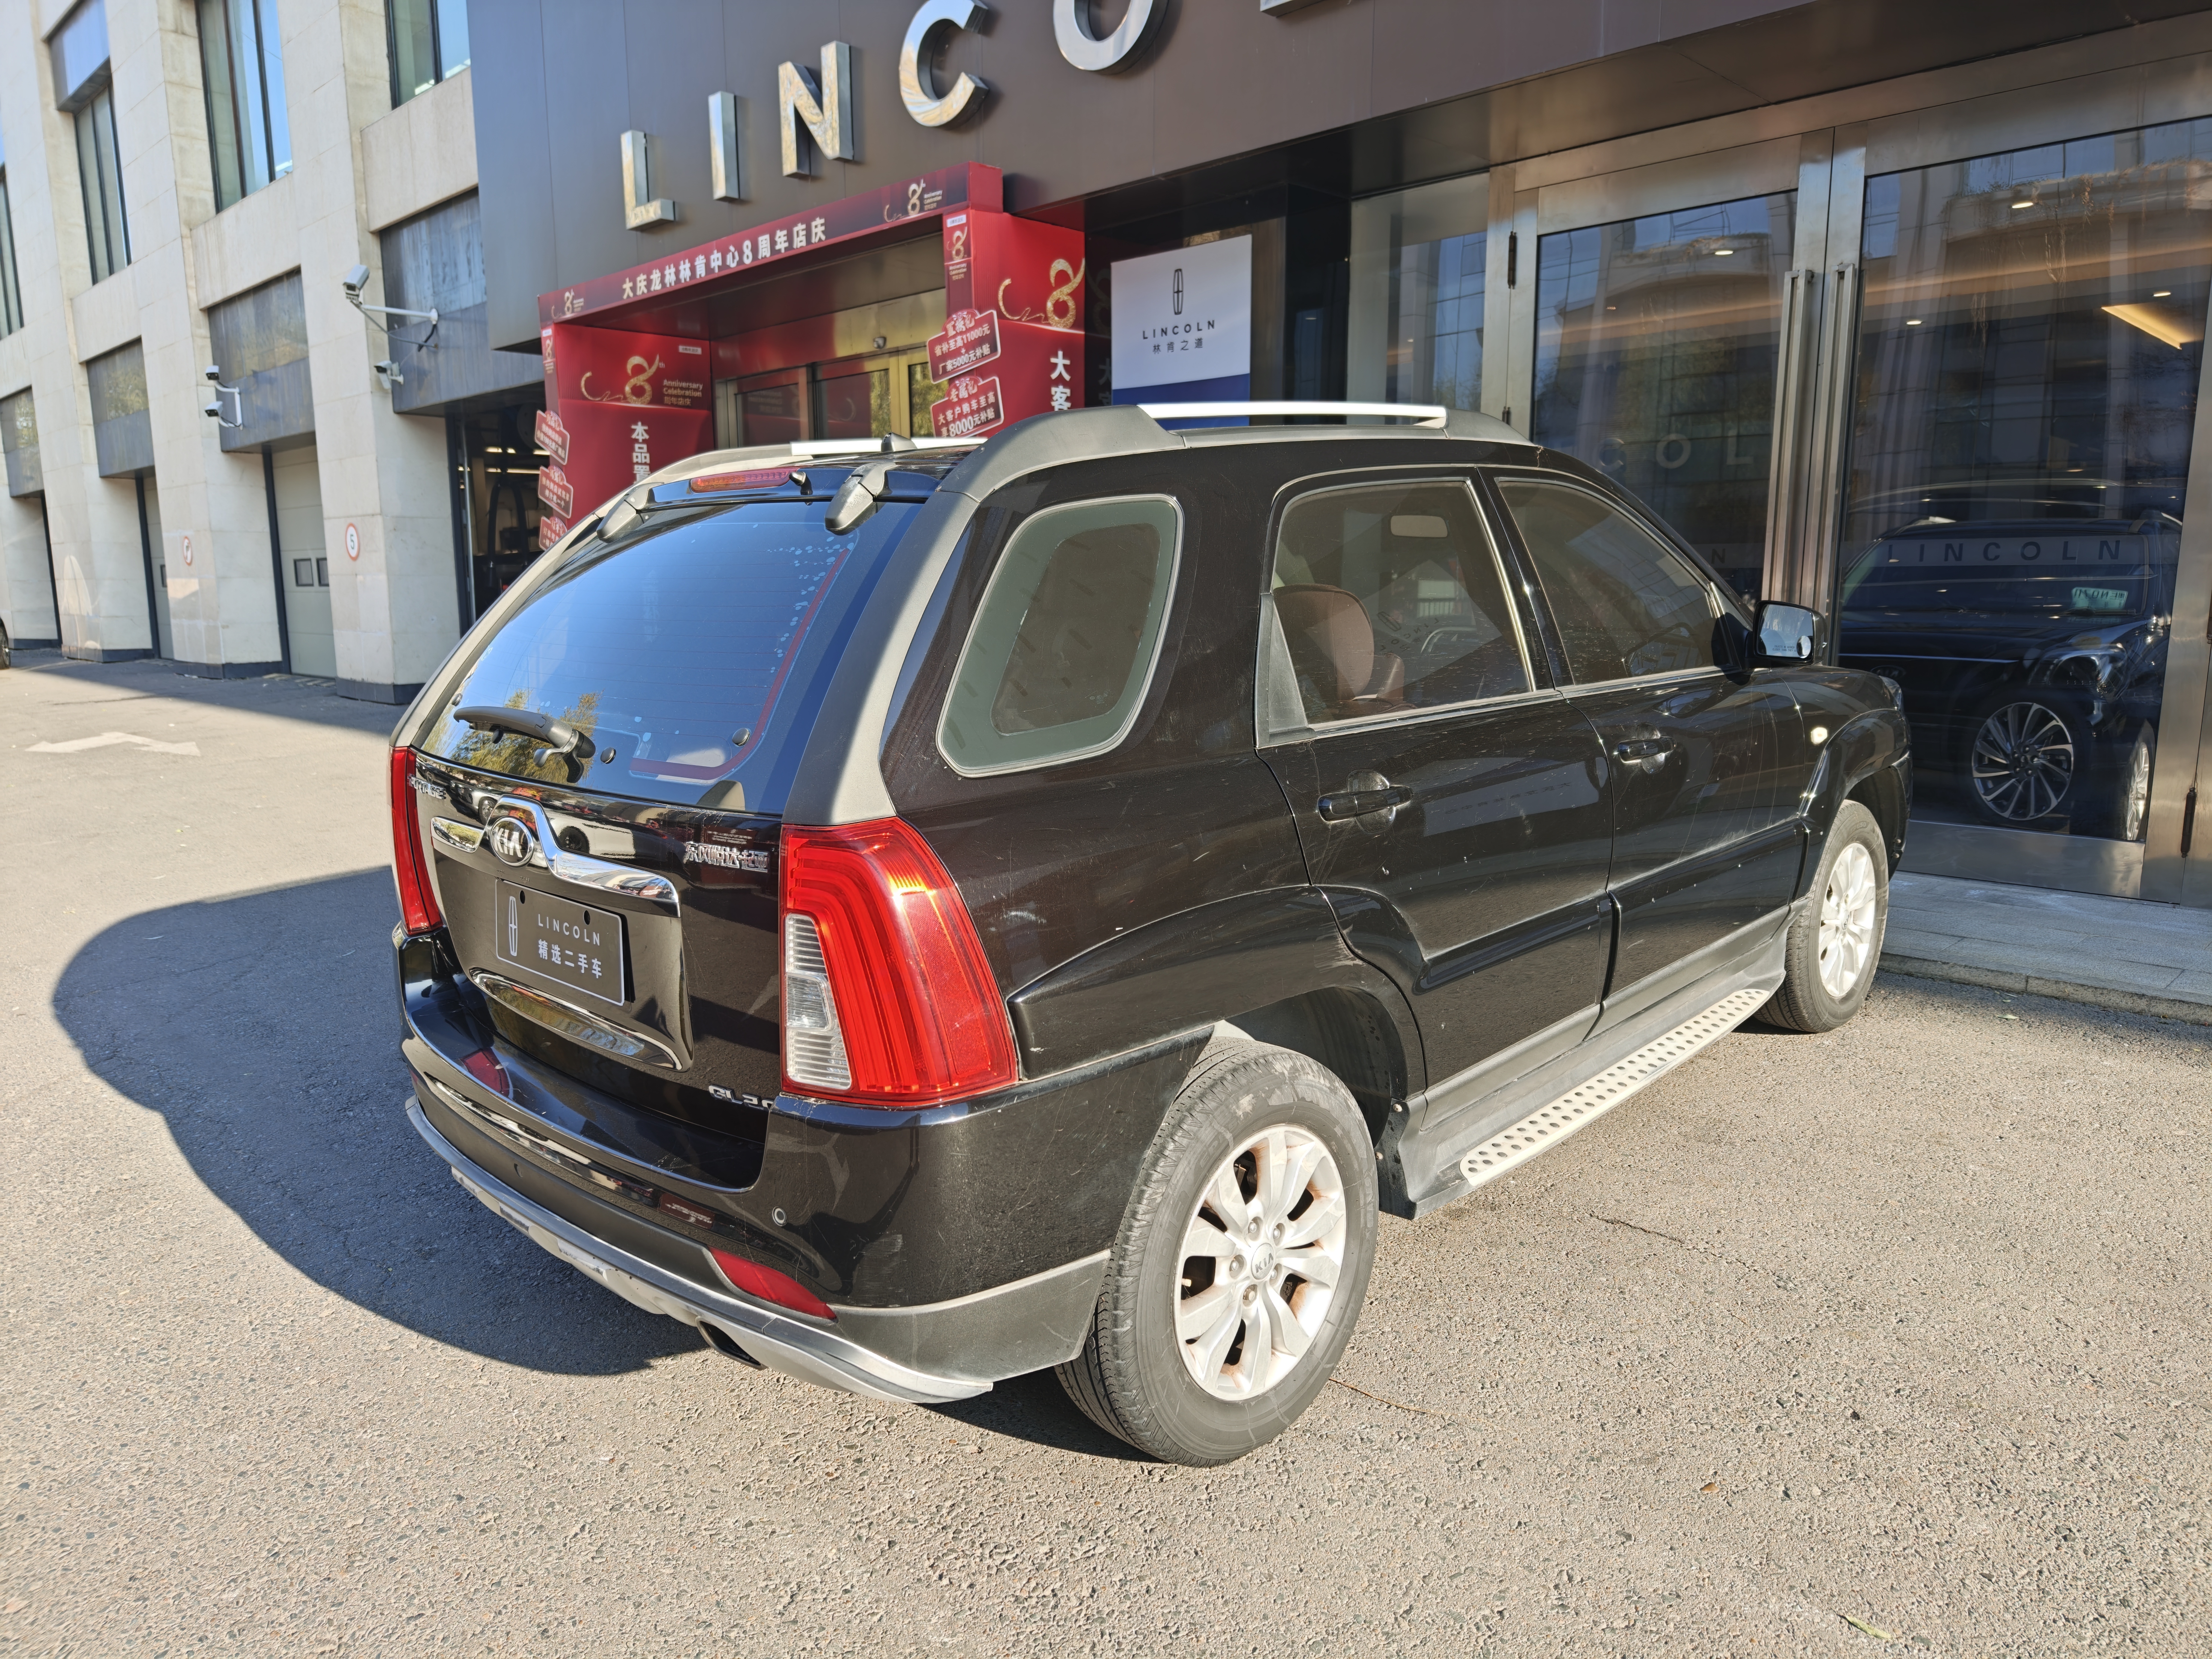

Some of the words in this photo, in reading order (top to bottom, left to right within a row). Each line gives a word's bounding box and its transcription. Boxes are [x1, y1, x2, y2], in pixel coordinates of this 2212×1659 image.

[621, 0, 1326, 230] LINCO
[623, 217, 826, 299] 大庆龙林林肯中心8周年店庆
[1142, 320, 1215, 339] LINCOLN
[1152, 337, 1204, 354] 林肯之道
[939, 343, 991, 375] 厂家5000元补贴
[663, 378, 703, 391] Anniversary
[663, 387, 702, 397] Celebration
[938, 391, 995, 425] 大客户购车至高
[941, 407, 995, 437] 享8000元补贴
[350, 534, 354, 550] 5
[1887, 540, 2121, 562] LINCOLN
[493, 826, 523, 858] KIA
[538, 914, 600, 946] LINCOLN
[538, 939, 602, 979] 精选二手车
[709, 1085, 744, 1105] GL
[1255, 1253, 1274, 1273] KIA
